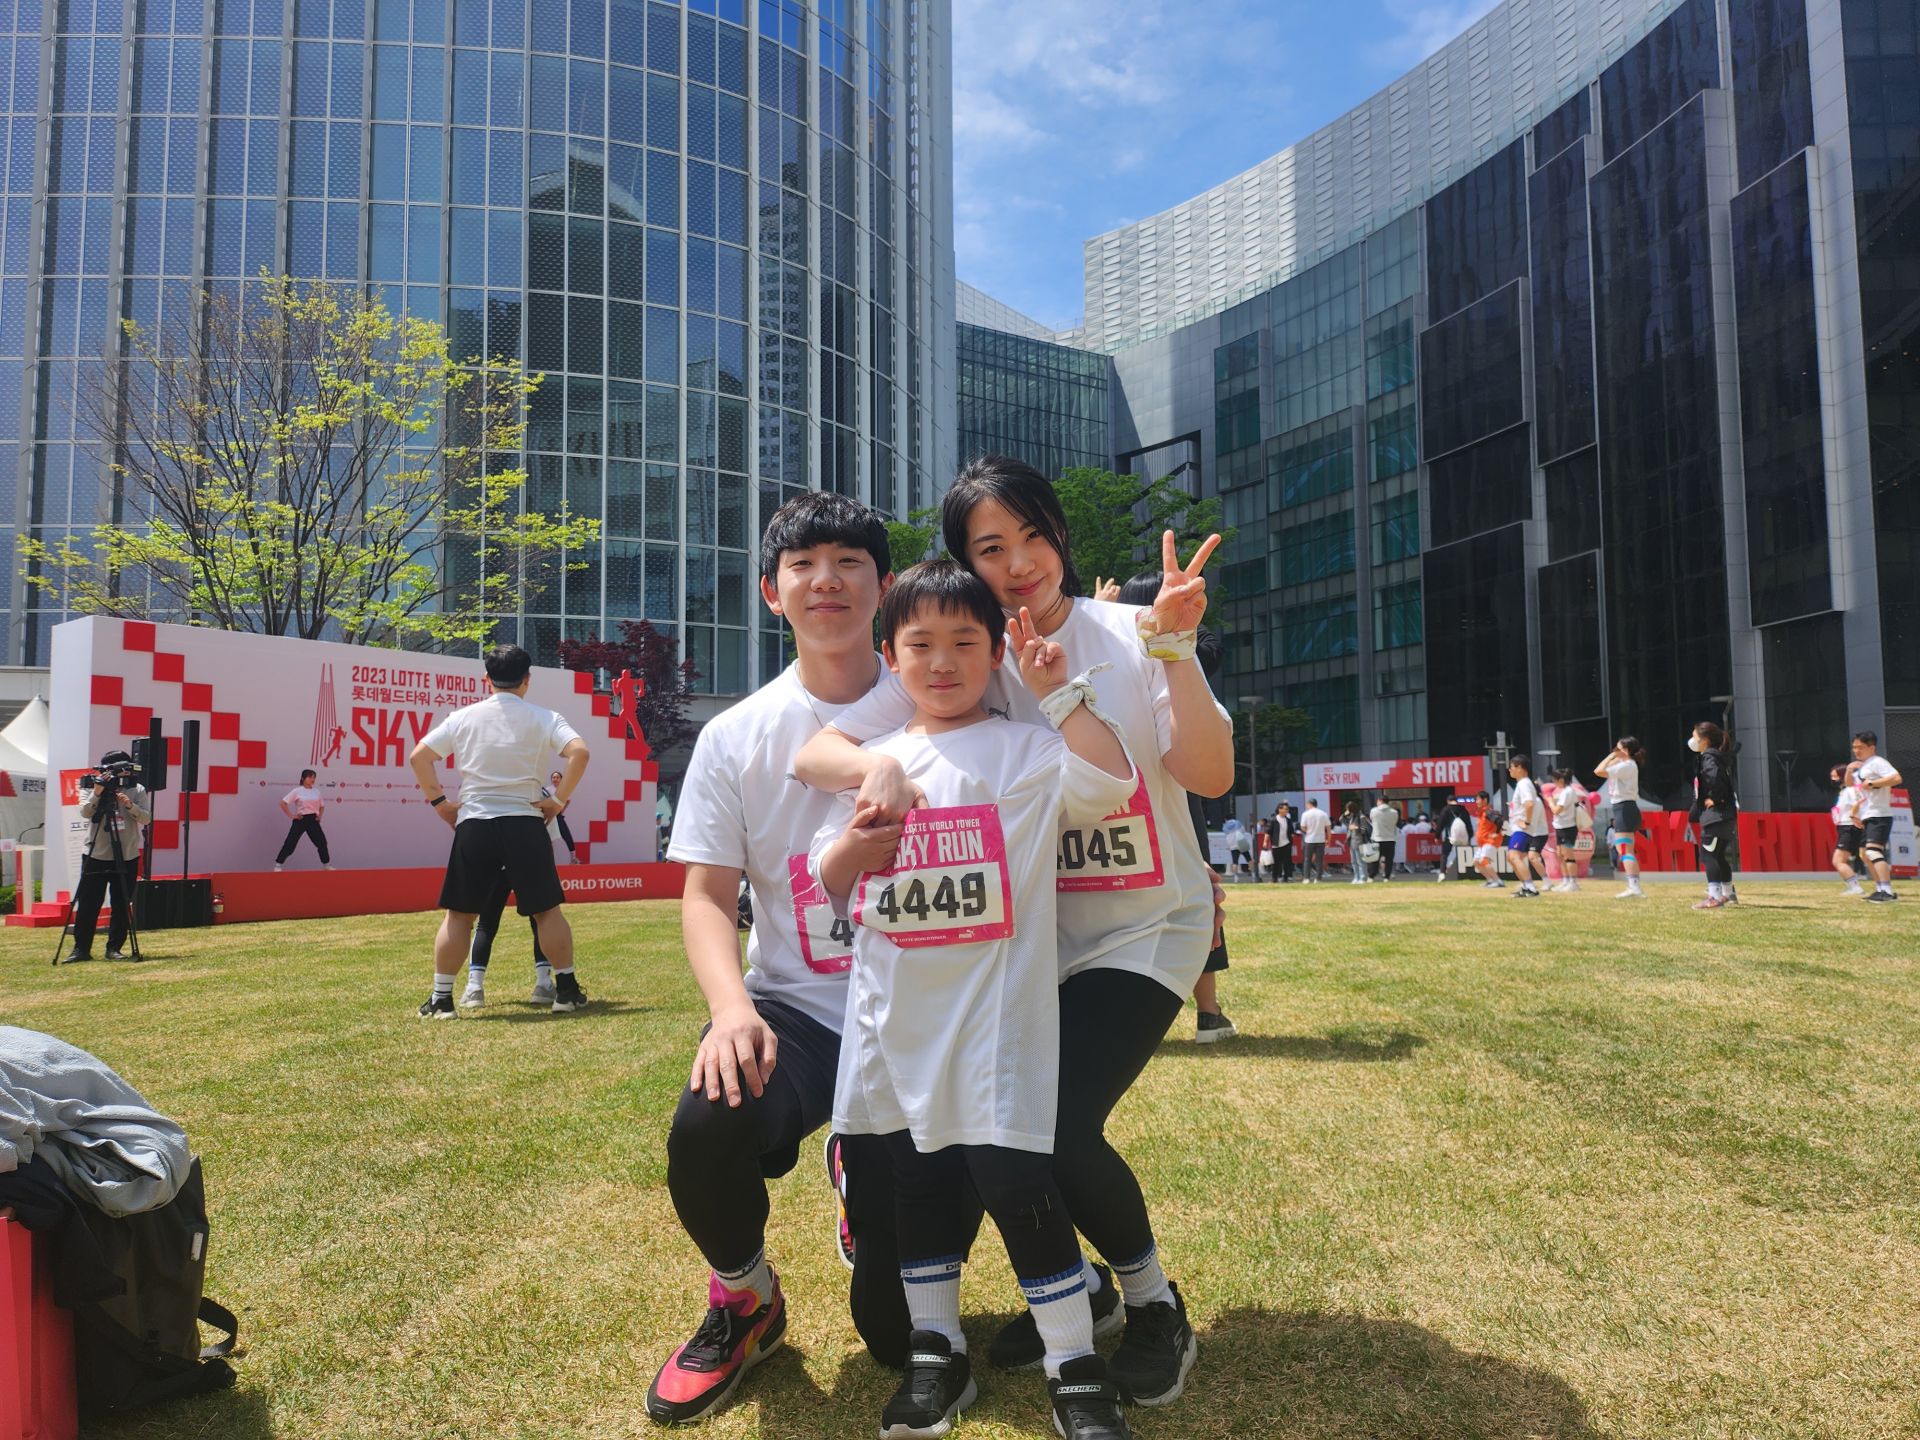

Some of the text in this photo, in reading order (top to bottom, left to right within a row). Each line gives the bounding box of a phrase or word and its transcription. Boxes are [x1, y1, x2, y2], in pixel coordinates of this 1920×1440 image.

[351, 665, 387, 685] 2023
[391, 669, 430, 689] LOTTE
[435, 673, 476, 693] WORLD
[351, 685, 431, 706] 롯데월드타워
[433, 693, 458, 709] 수직
[350, 706, 434, 768] SKY
[1323, 771, 1360, 785] SKY RUN
[1412, 760, 1472, 785] START
[905, 818, 980, 835] LOTTE WORLD TOWER
[937, 829, 985, 863] RUN
[560, 877, 643, 891] ORLD TOWER
[876, 871, 987, 923] 4449
[1058, 1385, 1100, 1393] SKECHERS
